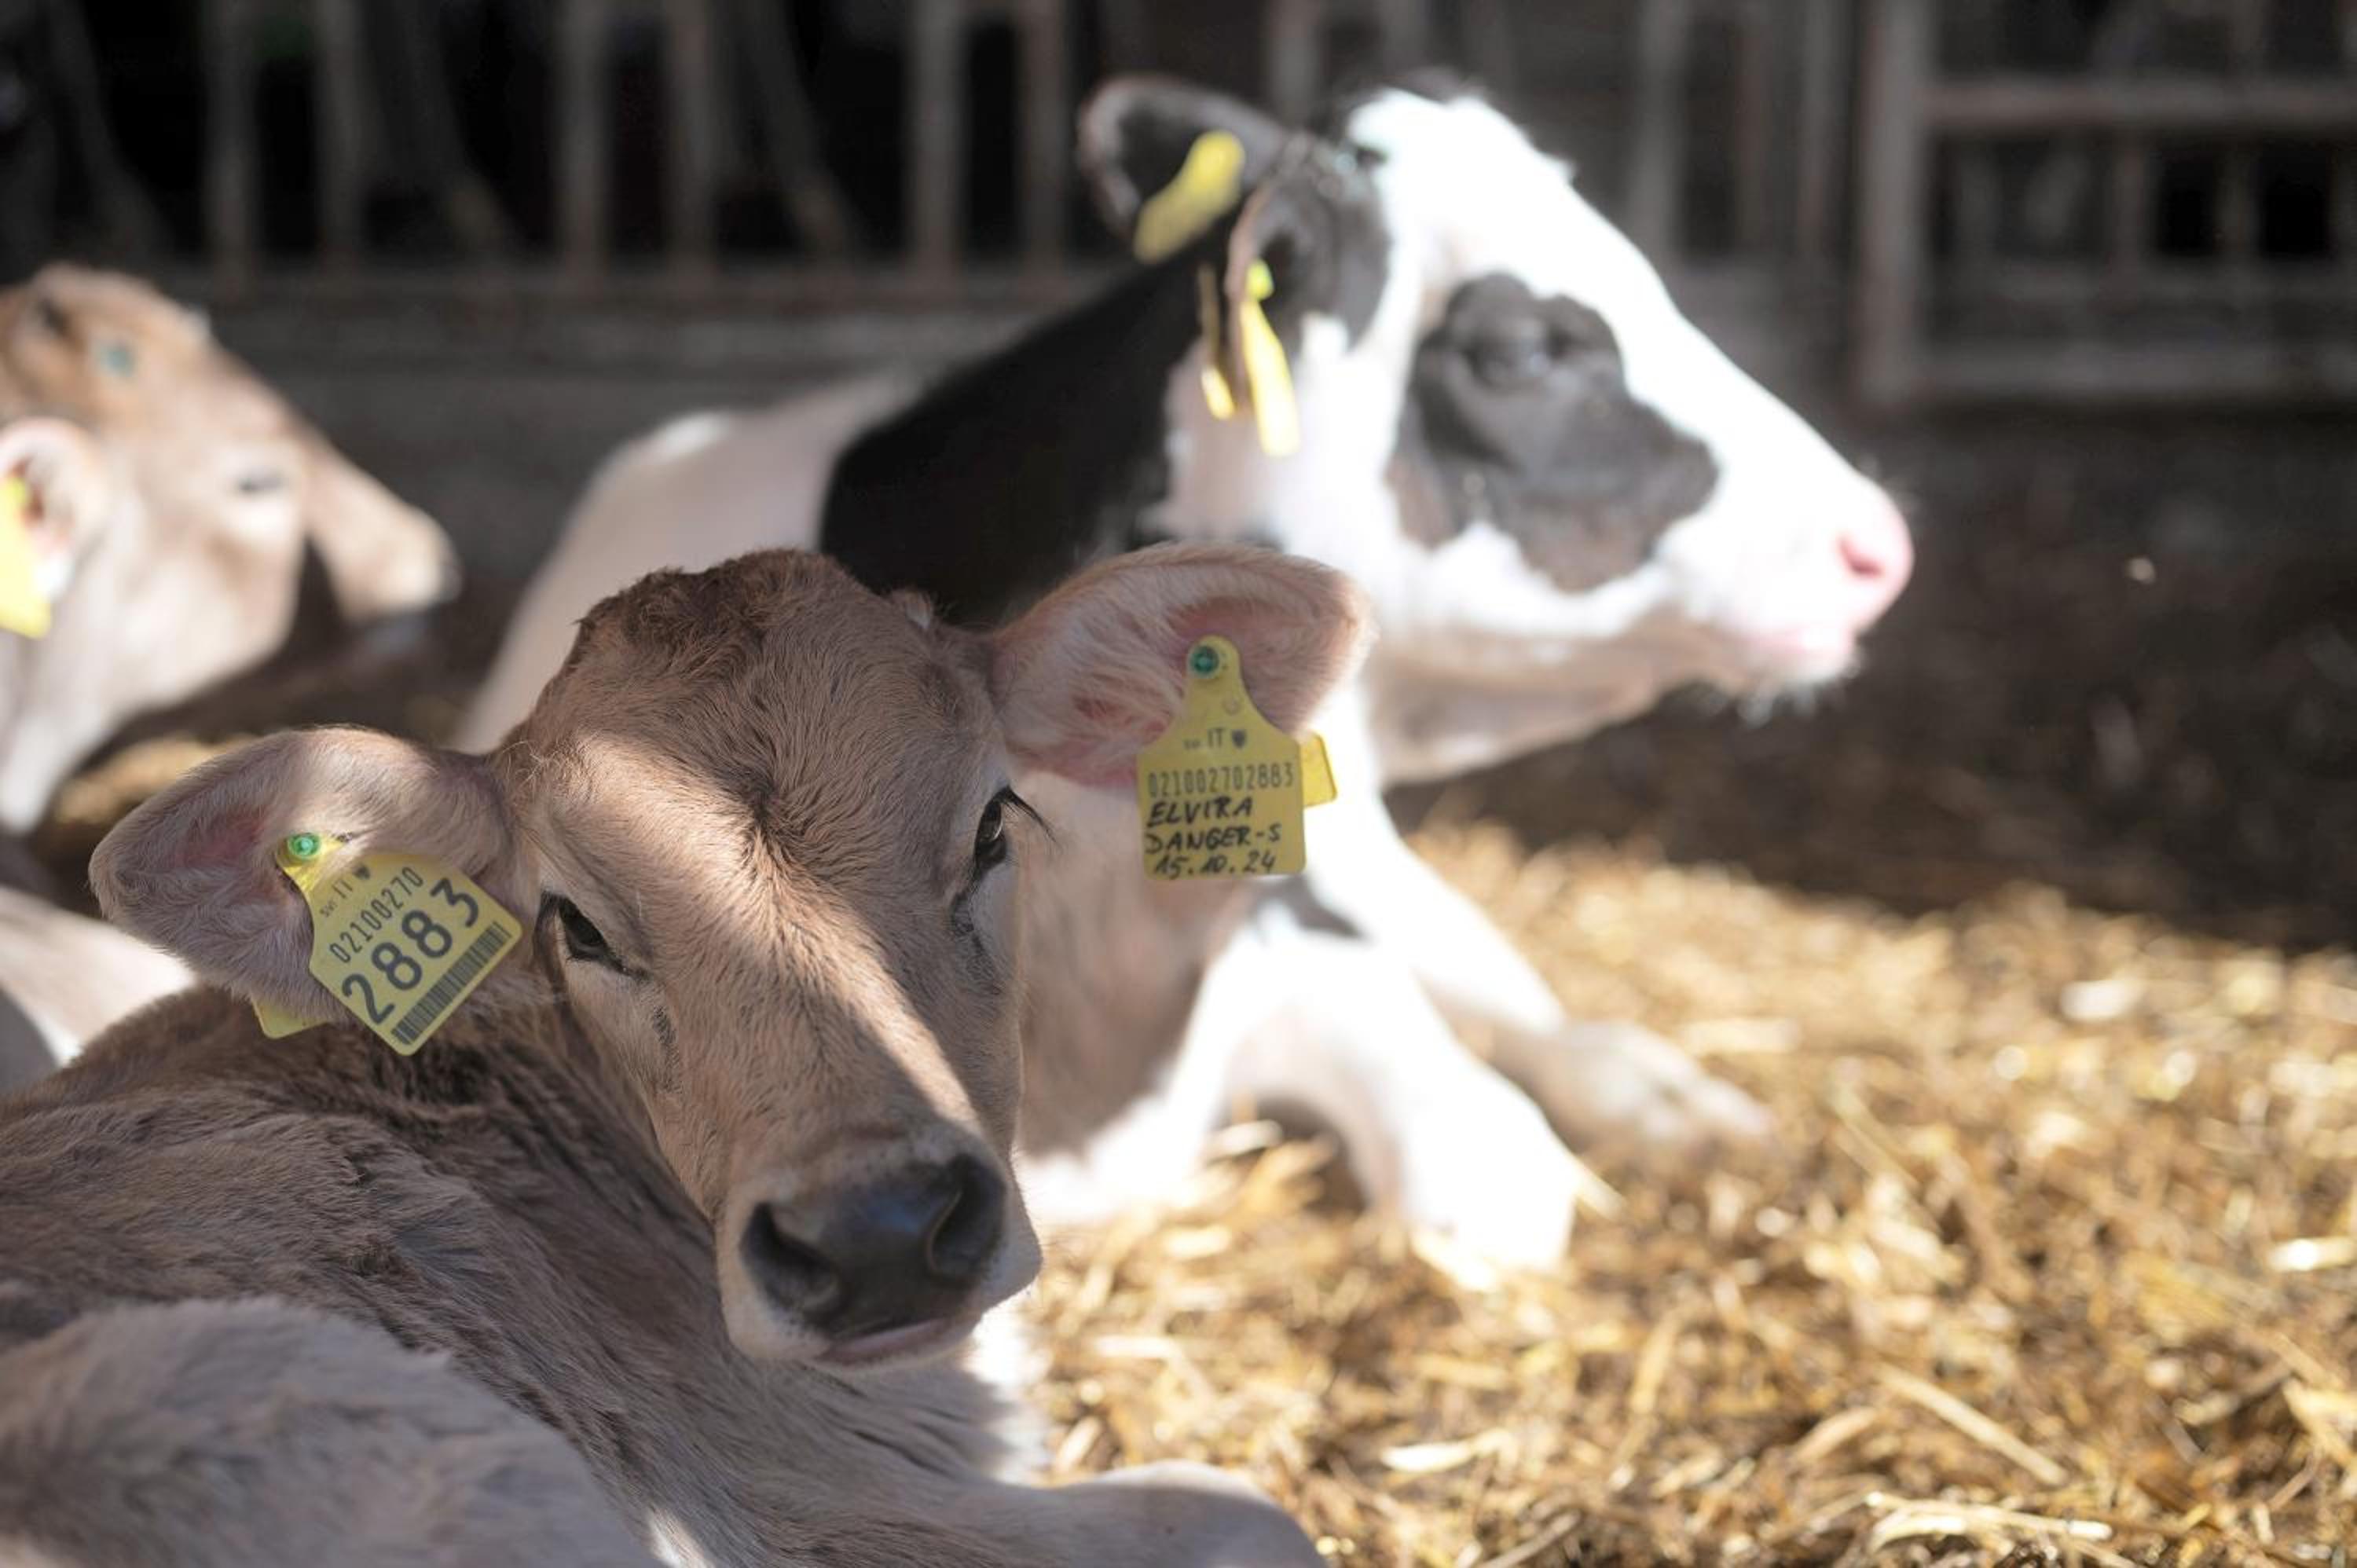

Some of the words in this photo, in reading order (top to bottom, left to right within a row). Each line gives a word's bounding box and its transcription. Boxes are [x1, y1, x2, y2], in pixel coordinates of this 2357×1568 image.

[1148, 761, 1294, 798] 021002702883
[1146, 796, 1253, 827] ELVIRA
[1154, 850, 1277, 880] 15.10.24
[329, 866, 424, 964] 02100270
[341, 877, 480, 1025] 2883
